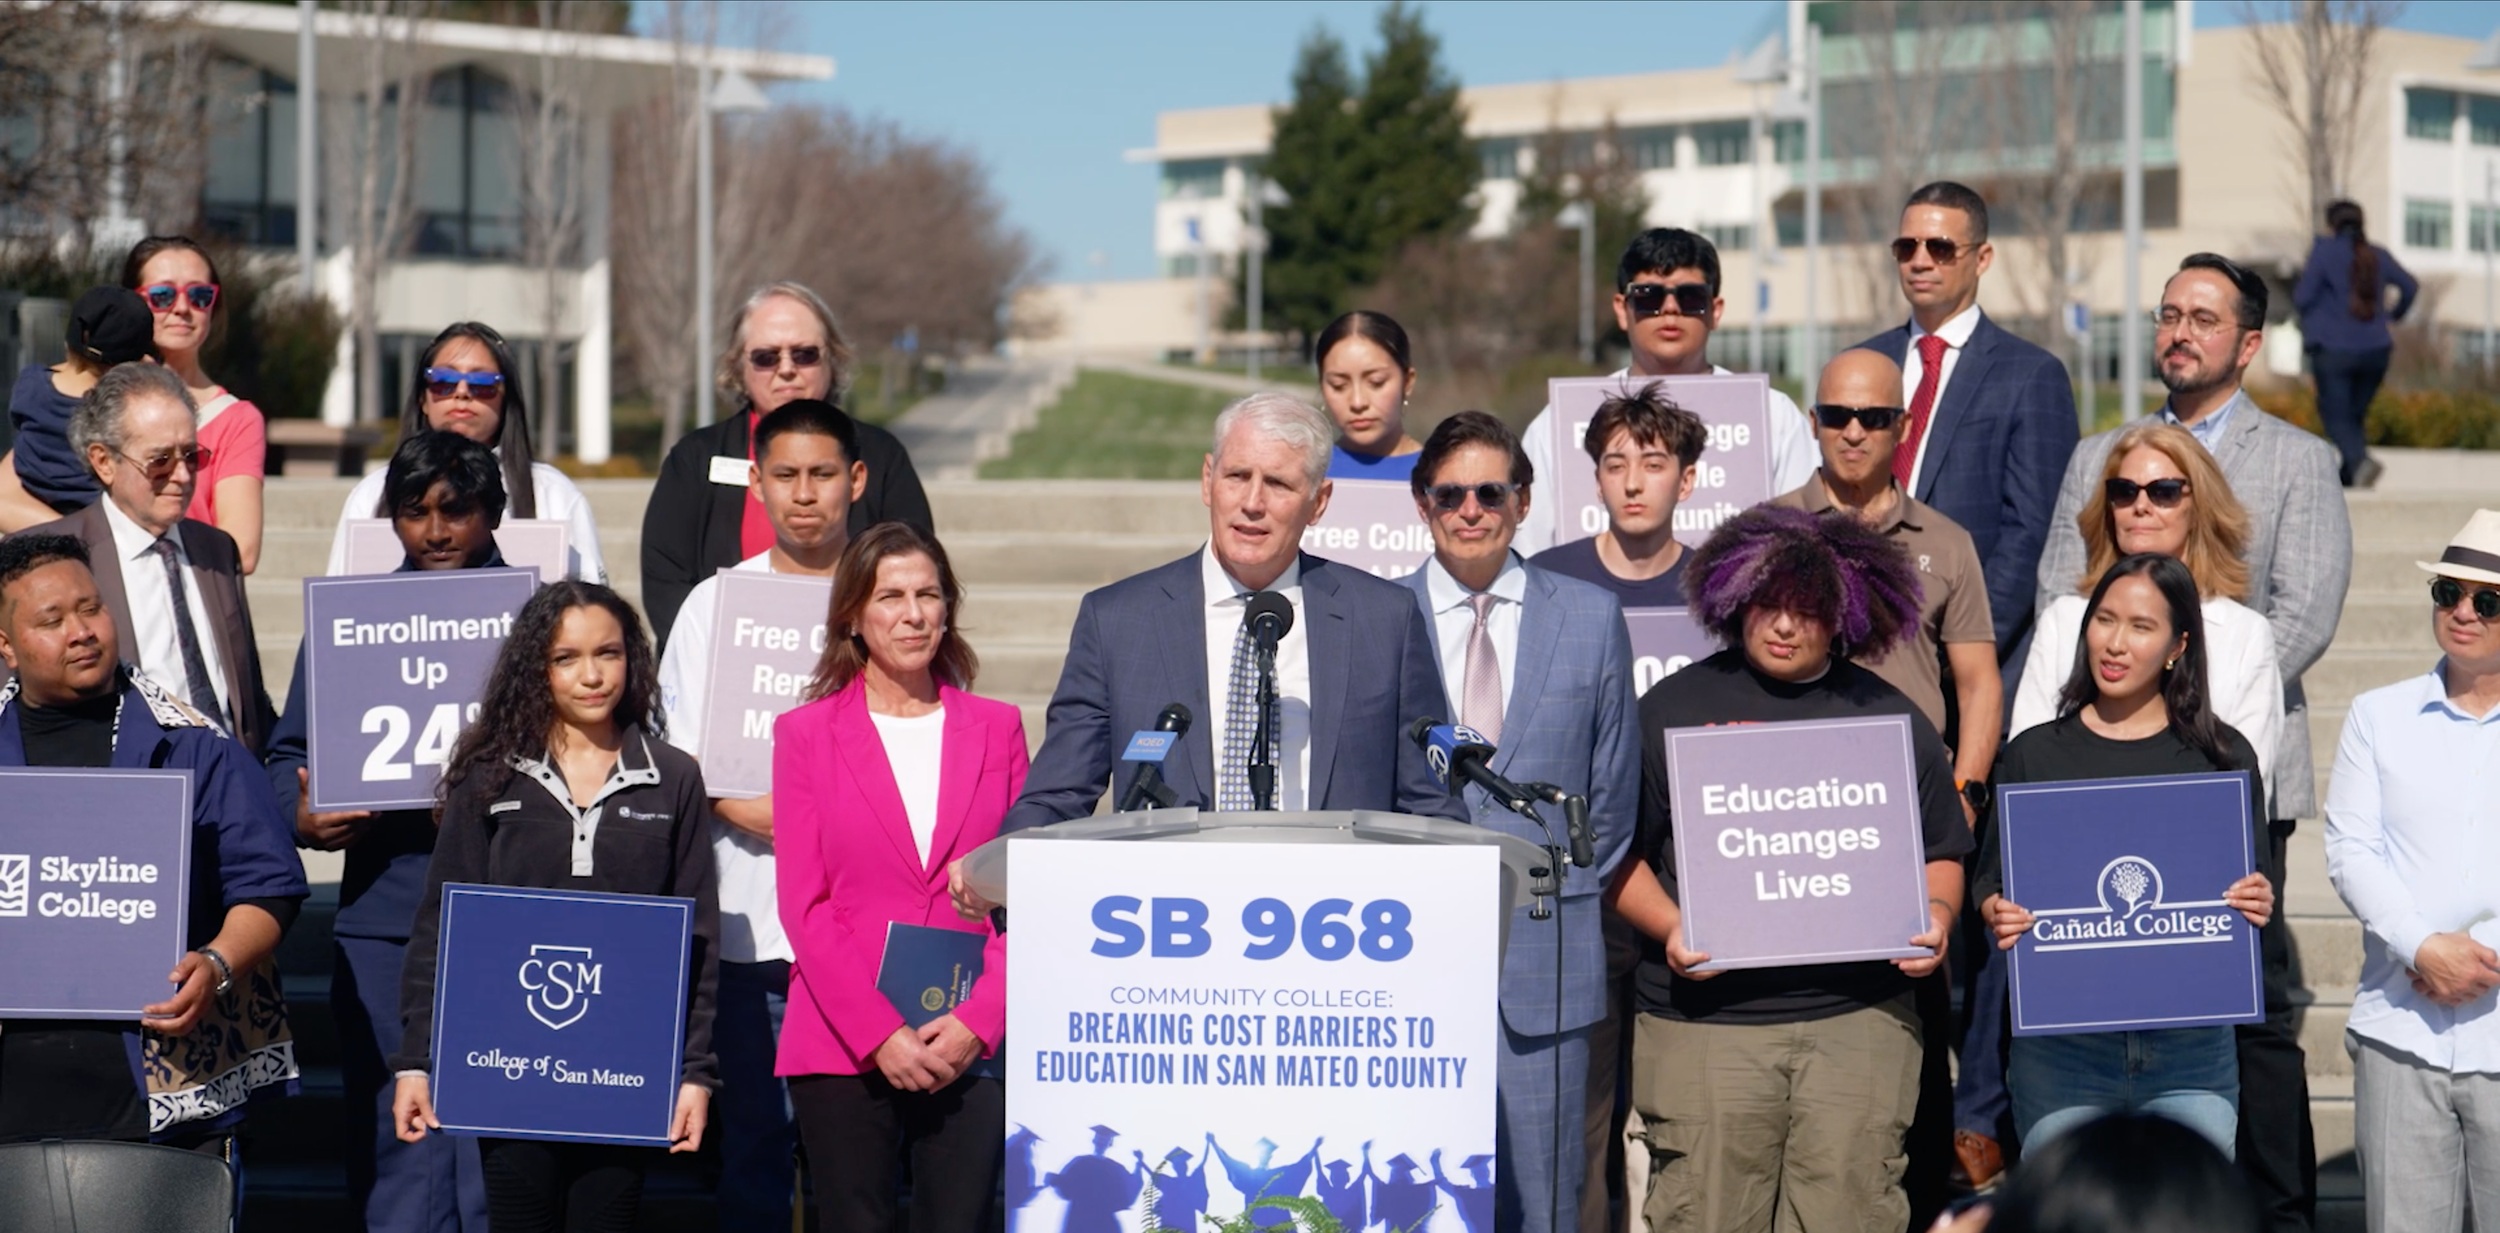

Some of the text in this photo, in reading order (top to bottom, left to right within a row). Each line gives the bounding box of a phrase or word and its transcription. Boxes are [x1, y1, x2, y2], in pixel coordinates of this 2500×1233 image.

[333, 611, 514, 647] Enrollment
[733, 617, 801, 651] Free
[401, 656, 448, 690] Up
[360, 702, 483, 782] 24
[1702, 777, 1887, 815] Education
[1717, 827, 1881, 860] Changes
[40, 856, 158, 888] Skyline
[1755, 871, 1852, 901] Lives
[38, 892, 157, 925] College
[2032, 910, 2233, 942] Cañada College
[1090, 895, 1414, 962] SB 968
[519, 959, 603, 1010] CSM
[1110, 986, 1393, 1008] COMMUNITY COLLEGE:
[1069, 1011, 1434, 1049] BREAKING COST BARRIERS TO
[466, 1048, 645, 1088] College of San Mateo
[1036, 1051, 1467, 1089] EDUCATION IN SAN MATEO COUNTY
